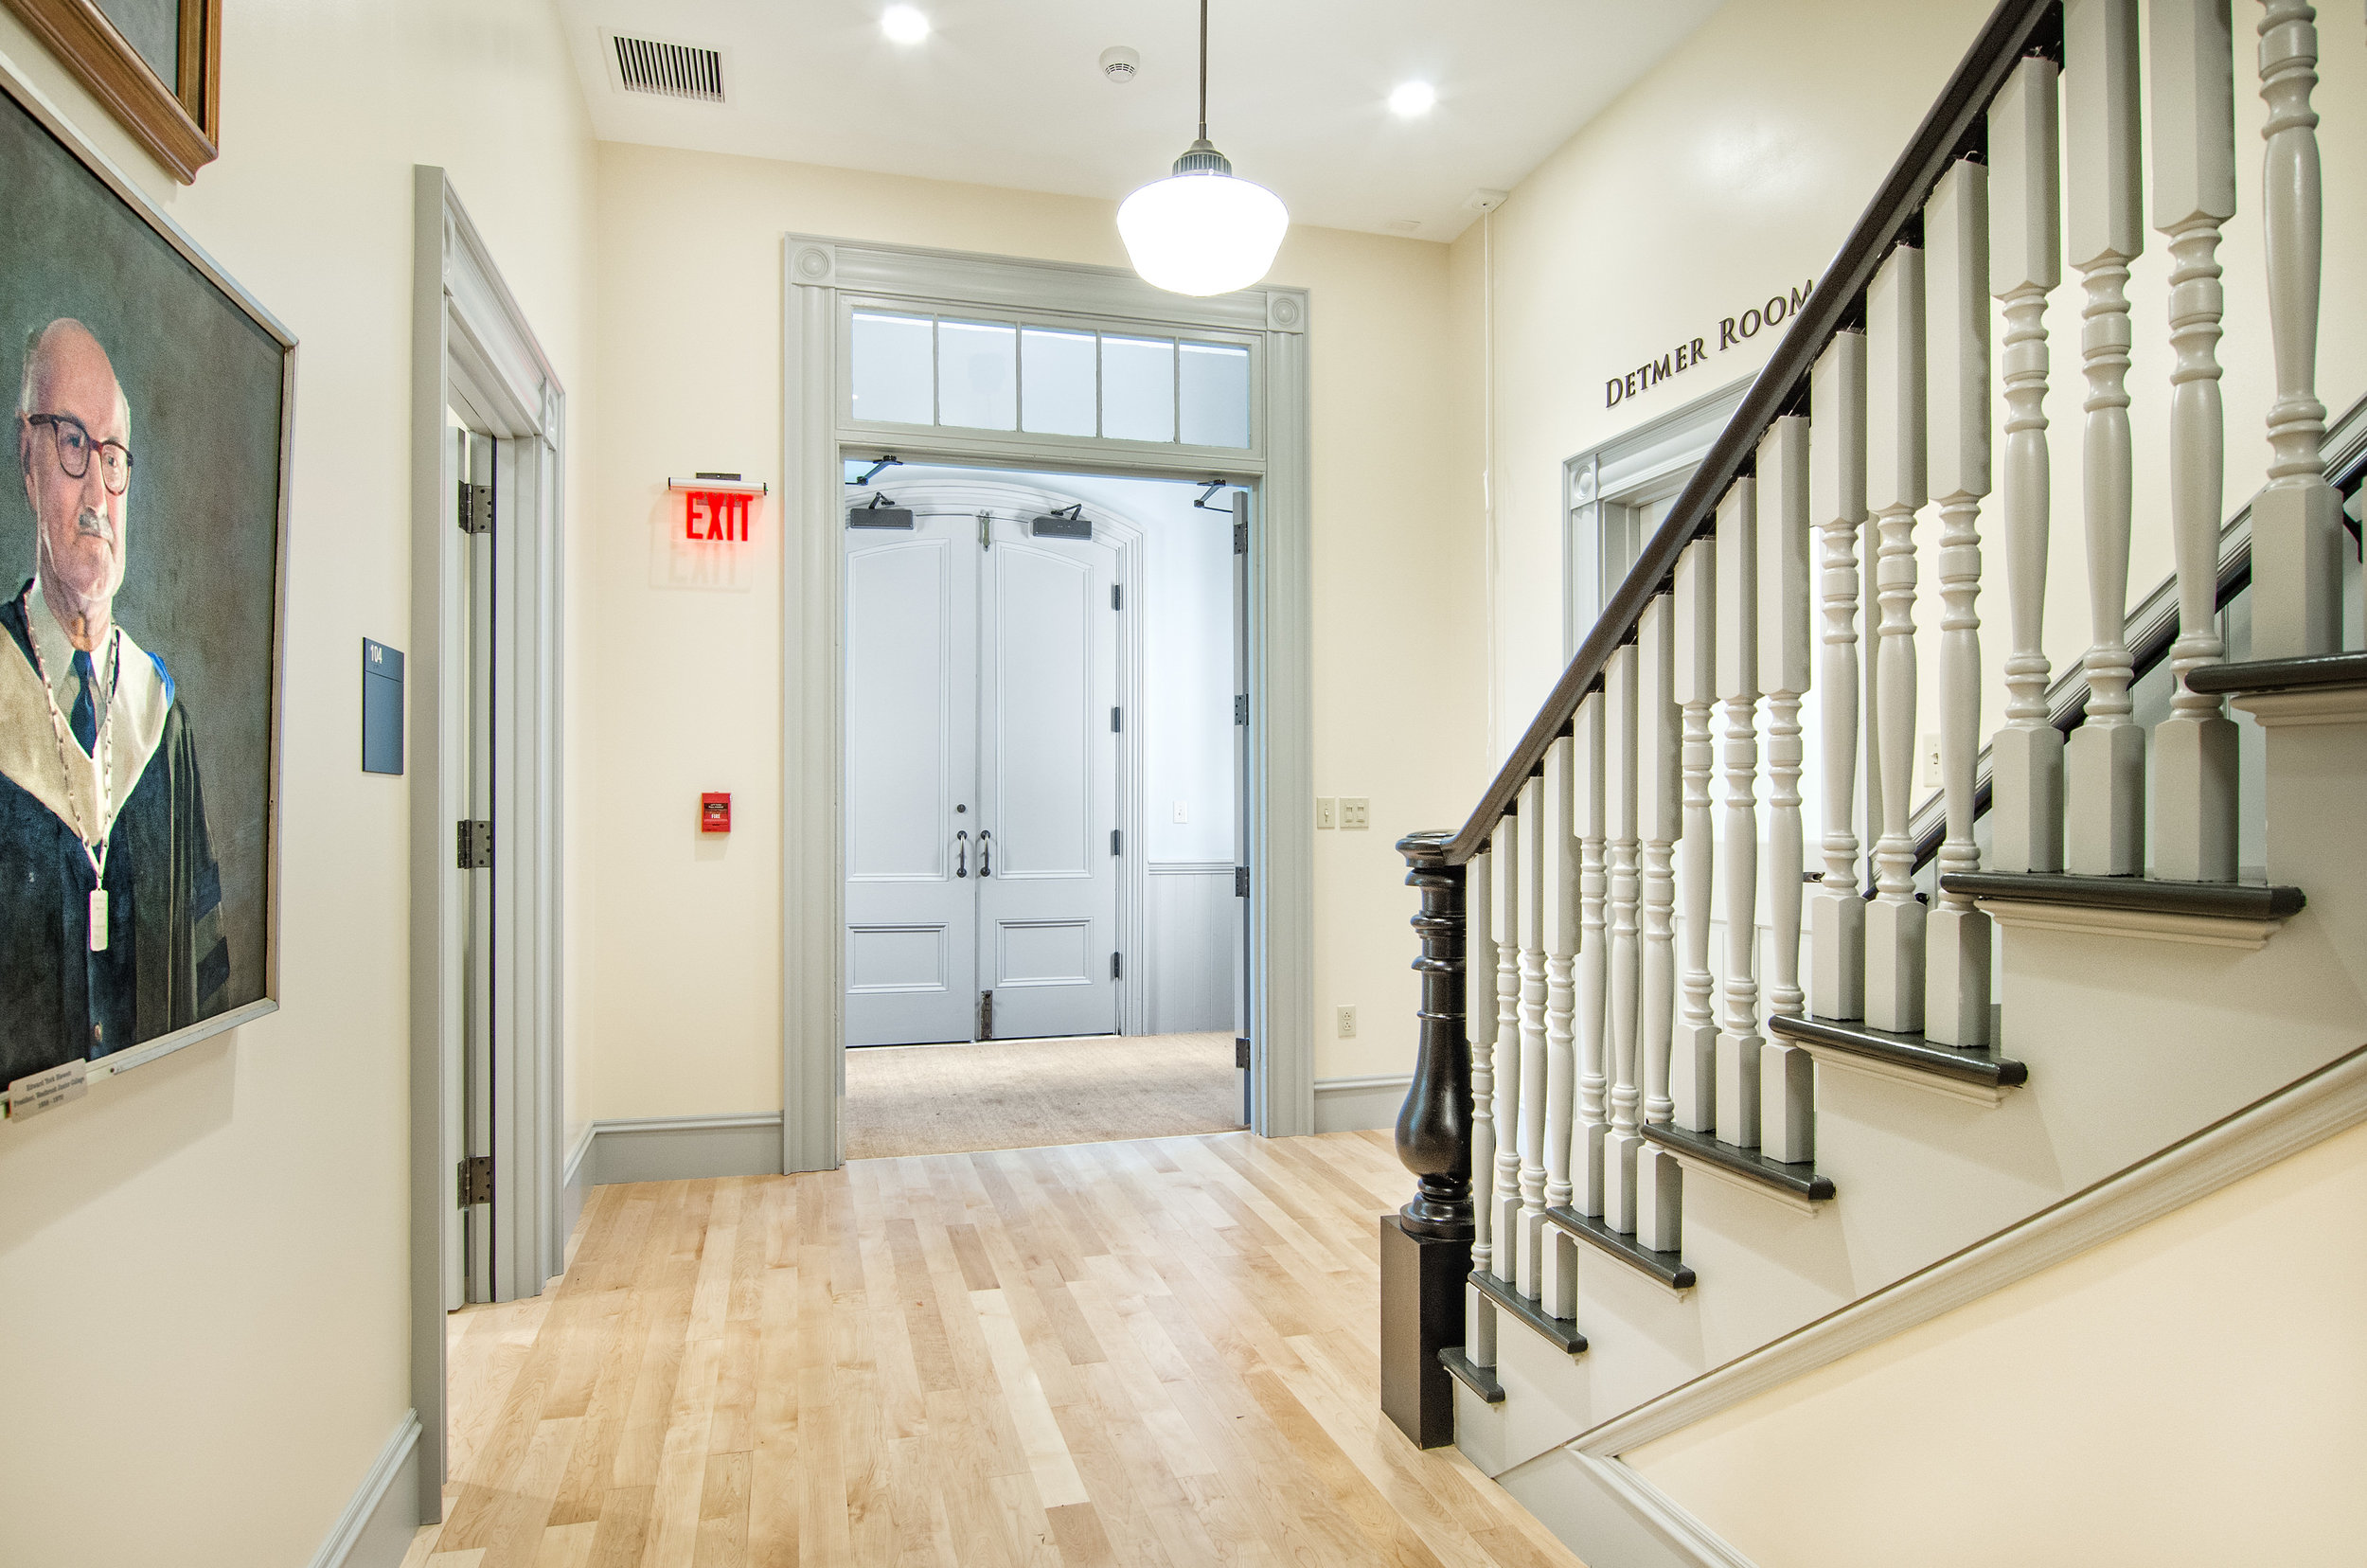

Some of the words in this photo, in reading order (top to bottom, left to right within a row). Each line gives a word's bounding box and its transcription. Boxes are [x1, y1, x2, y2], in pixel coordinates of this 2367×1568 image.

[1606, 337, 1707, 408] DETMER
[1718, 278, 1813, 351] ROOM
[686, 491, 753, 541] EXIT
[370, 645, 382, 664] 104
